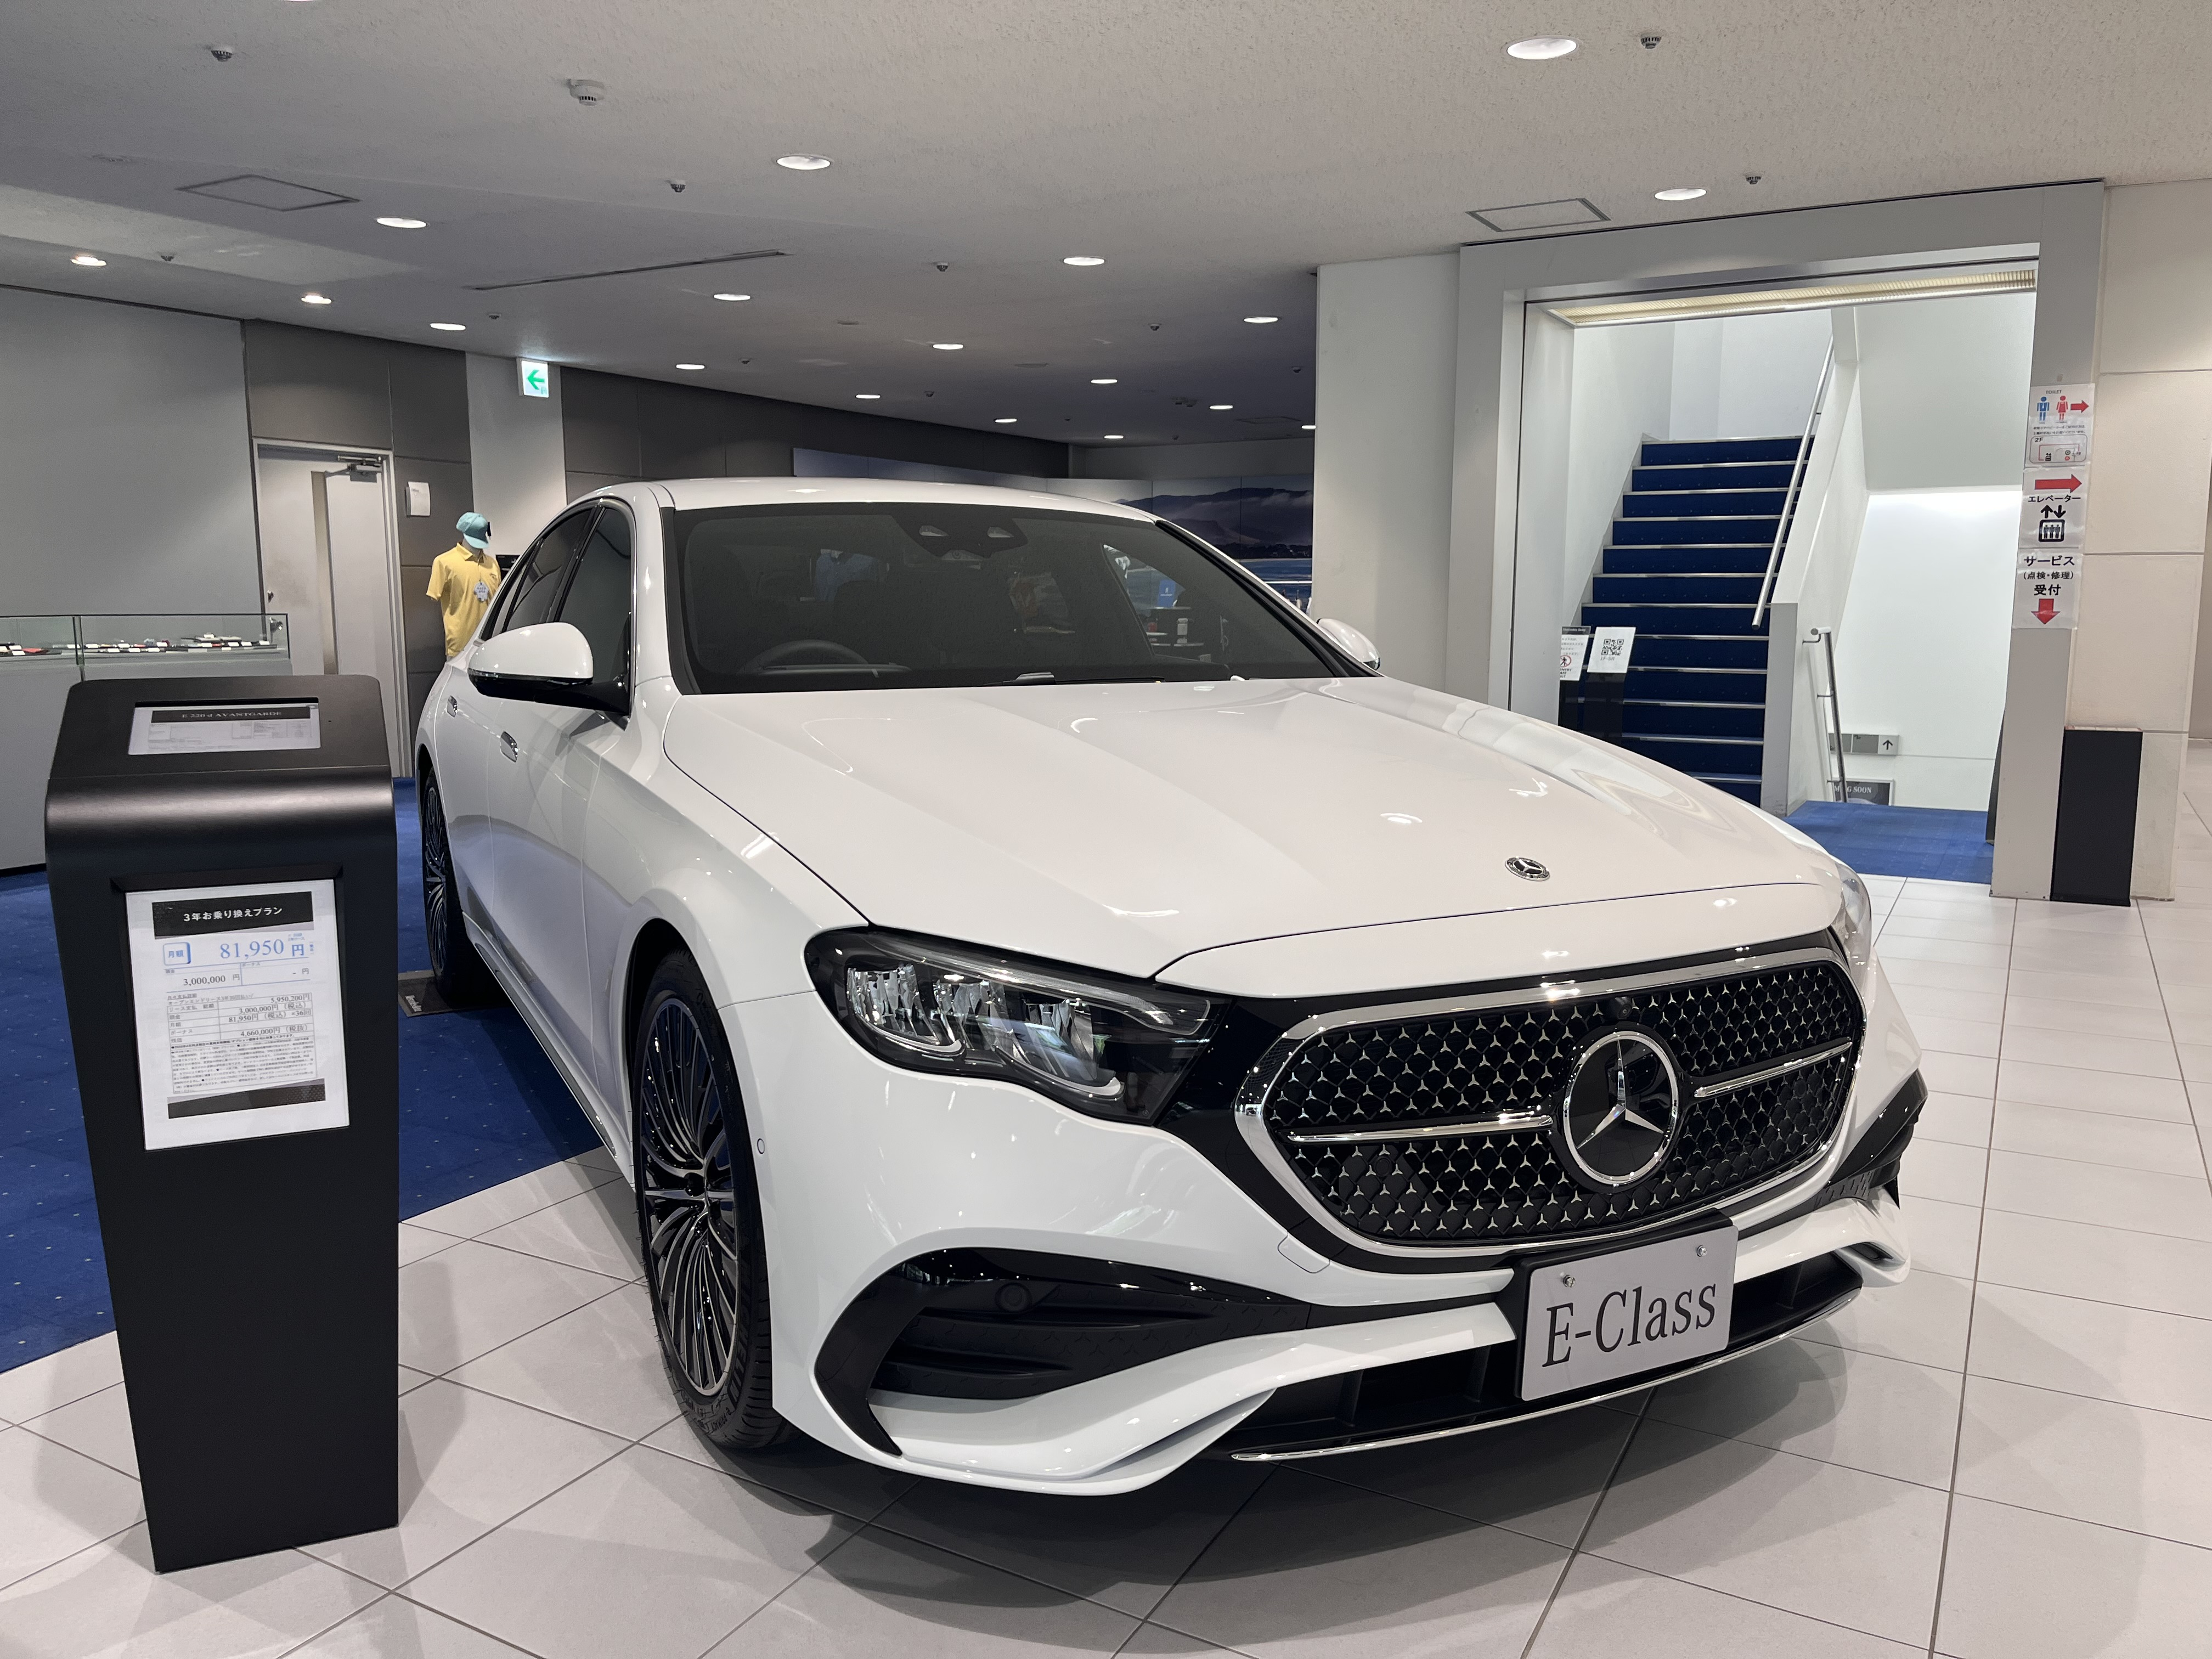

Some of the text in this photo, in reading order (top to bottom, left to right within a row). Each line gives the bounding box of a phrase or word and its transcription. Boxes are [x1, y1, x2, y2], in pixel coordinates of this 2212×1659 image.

[2028, 494, 2081, 503] エレベーター
[2023, 555, 2075, 567] サービス
[2034, 584, 2061, 596] 受付
[183, 907, 283, 922] 3年お乗り換えプラン
[168, 950, 184, 958] 月額
[220, 939, 284, 960] 81,950
[291, 944, 304, 957] 円
[183, 975, 226, 986] 3,000,000
[1542, 1283, 1717, 1368] E-Class
